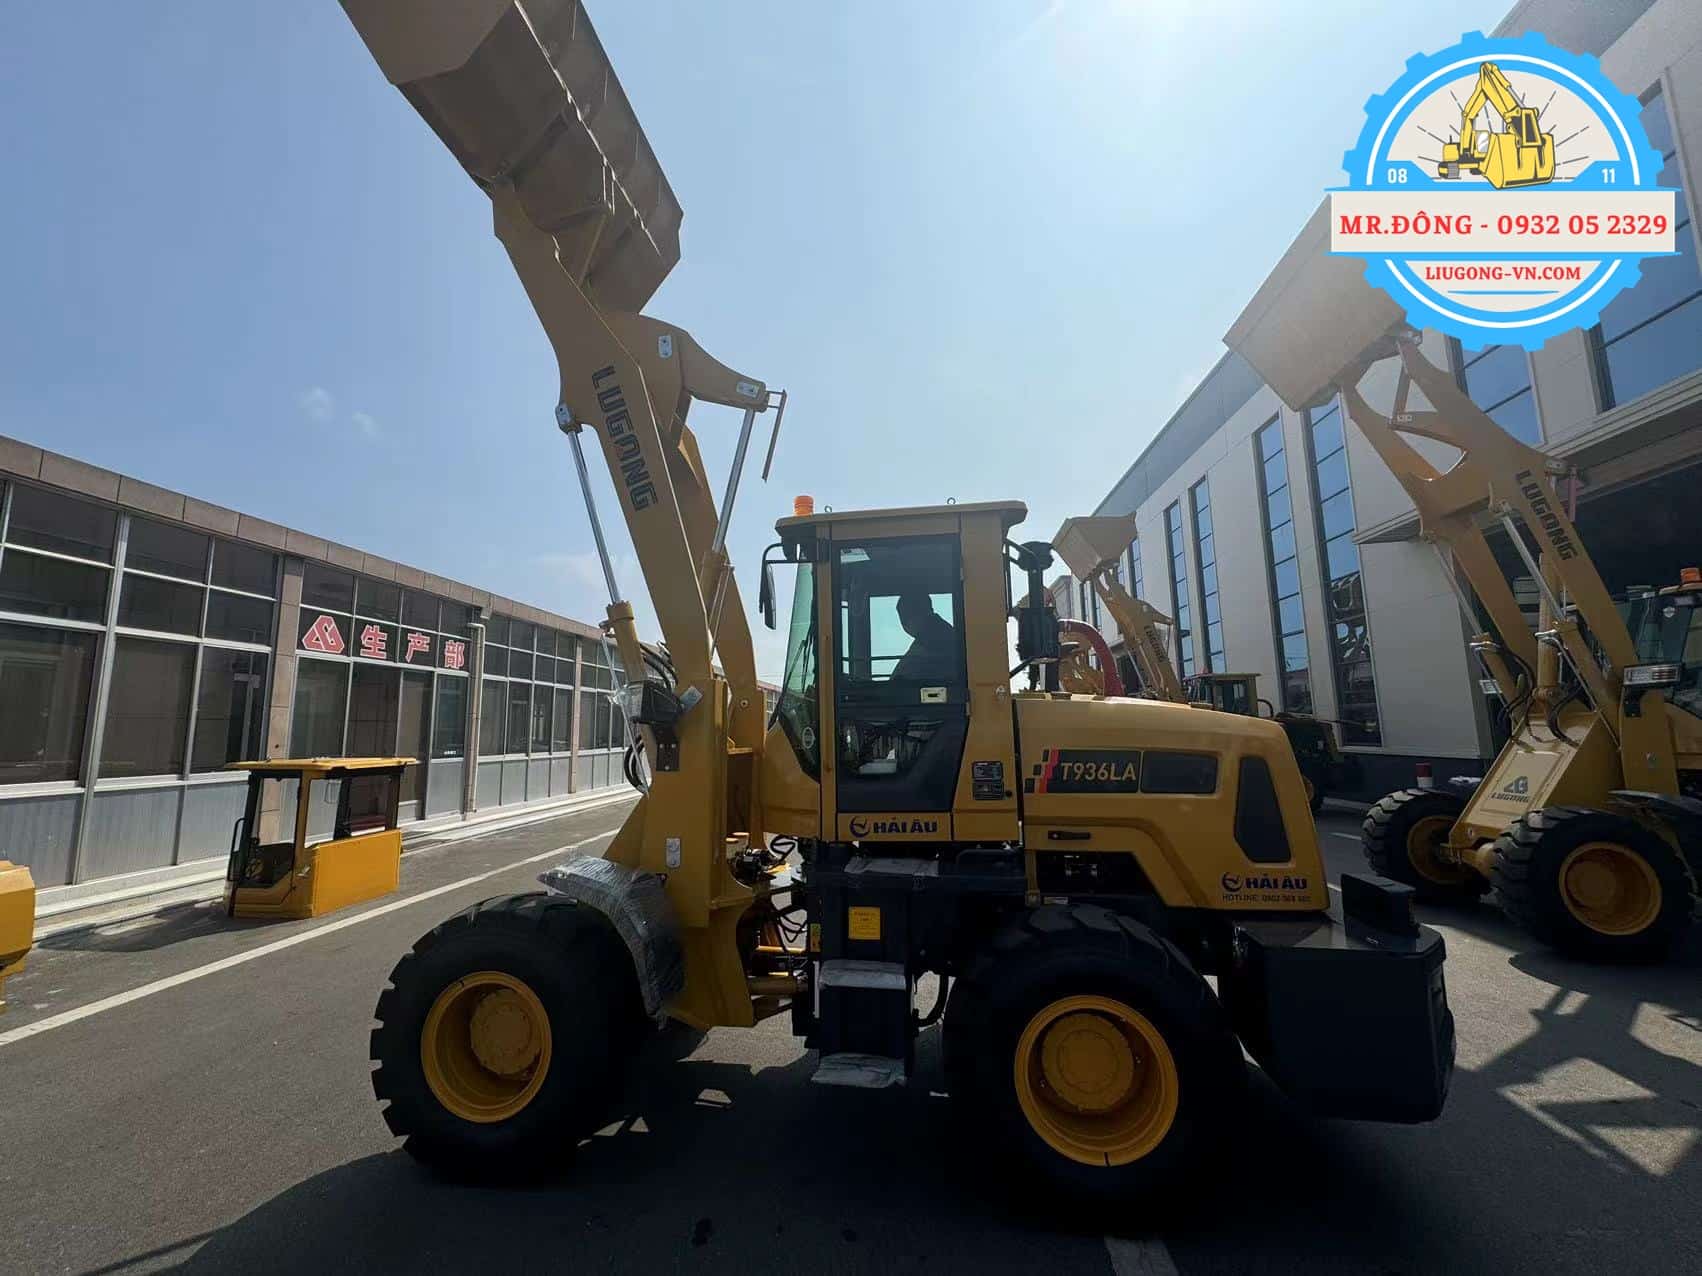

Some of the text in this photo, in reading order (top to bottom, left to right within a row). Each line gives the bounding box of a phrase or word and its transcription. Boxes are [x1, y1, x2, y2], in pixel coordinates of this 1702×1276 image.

[591, 365, 658, 511] LUGONG
[1516, 469, 1578, 560] LUGONG
[360, 624, 465, 669] 生产部
[1061, 762, 1137, 781] T936LA
[911, 818, 938, 833] ÂU
